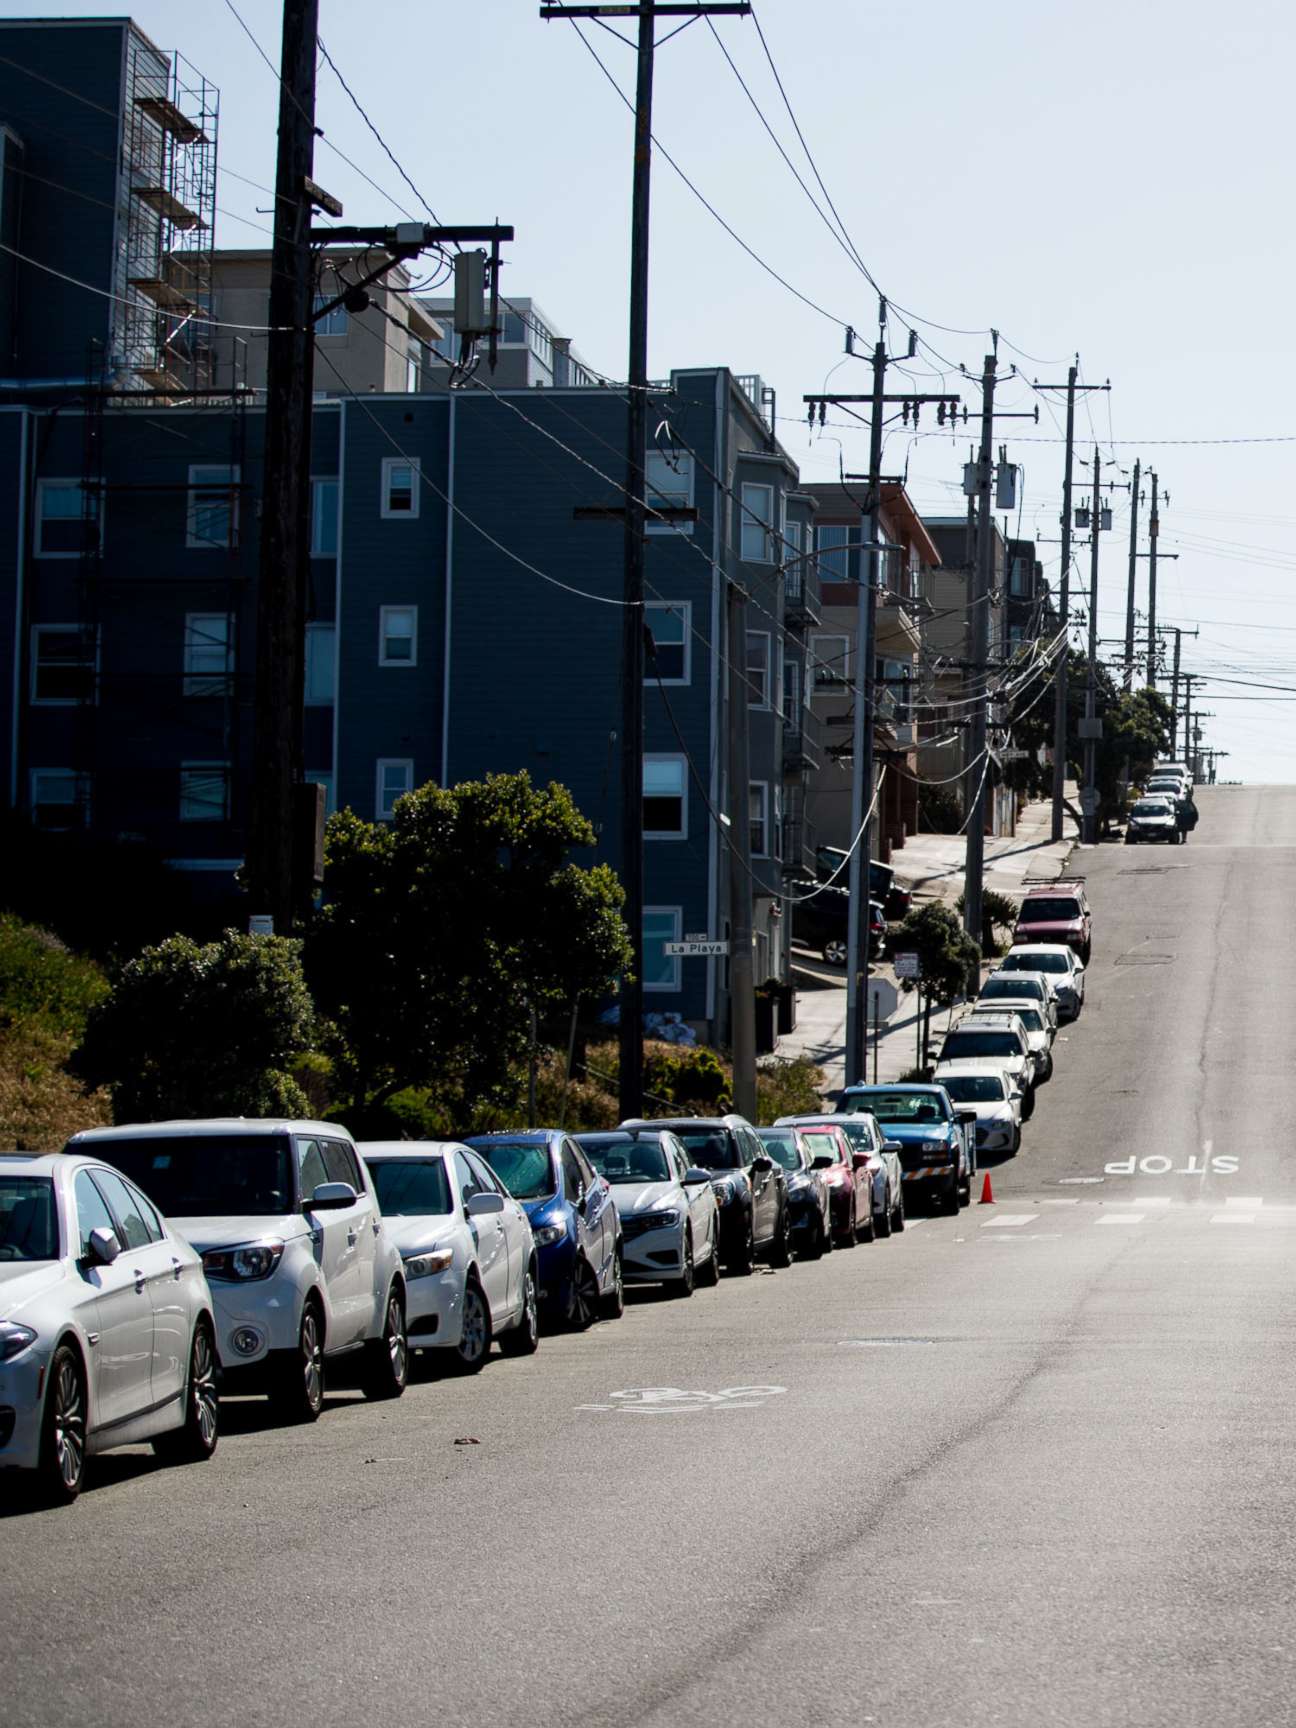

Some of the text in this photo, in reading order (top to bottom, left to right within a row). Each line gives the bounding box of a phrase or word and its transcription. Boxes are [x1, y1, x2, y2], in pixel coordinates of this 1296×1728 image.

[671, 943, 722, 955] La Playa
[1104, 1155, 1239, 1174] STOP
